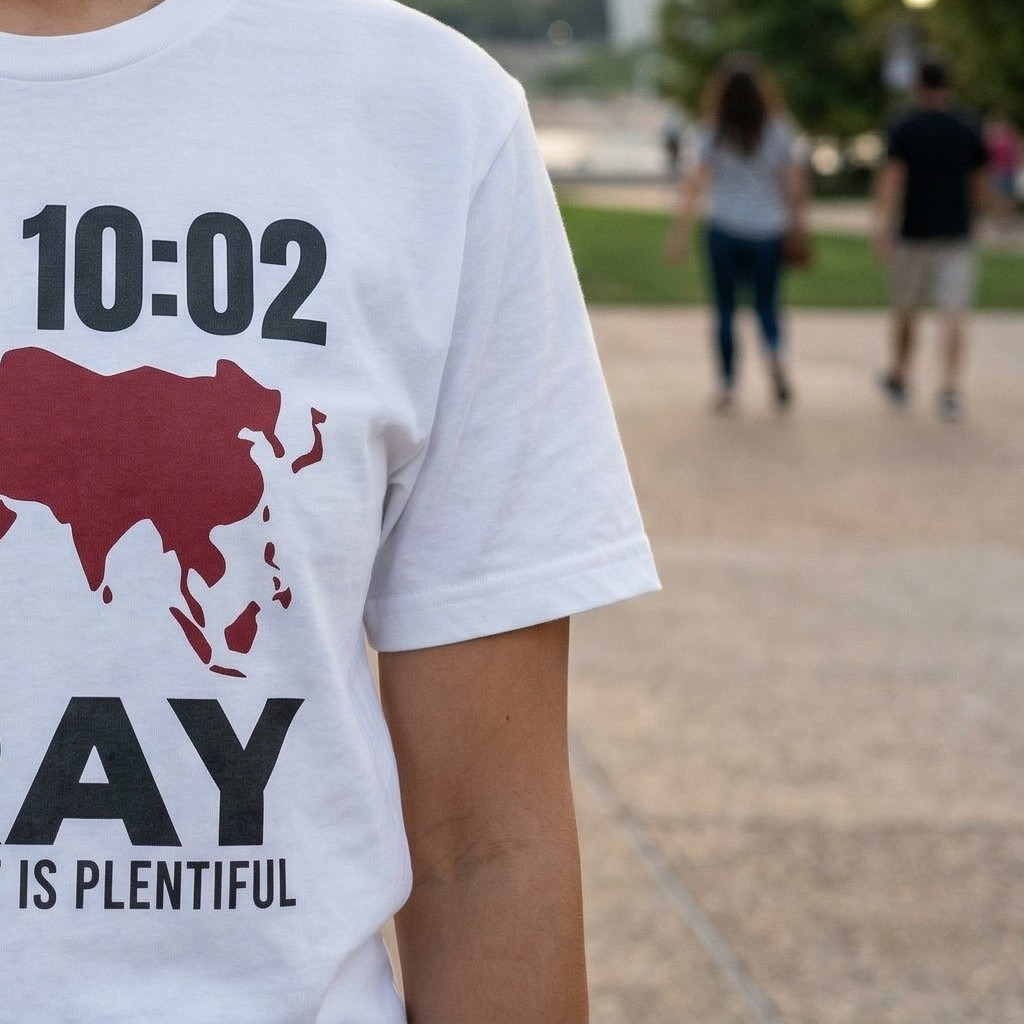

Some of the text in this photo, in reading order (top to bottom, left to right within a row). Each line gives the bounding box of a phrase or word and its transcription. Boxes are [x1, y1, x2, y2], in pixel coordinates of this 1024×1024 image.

[22, 204, 328, 347] 10:02
[18, 858, 57, 910] IS
[75, 858, 297, 911] PLENTIFUL
